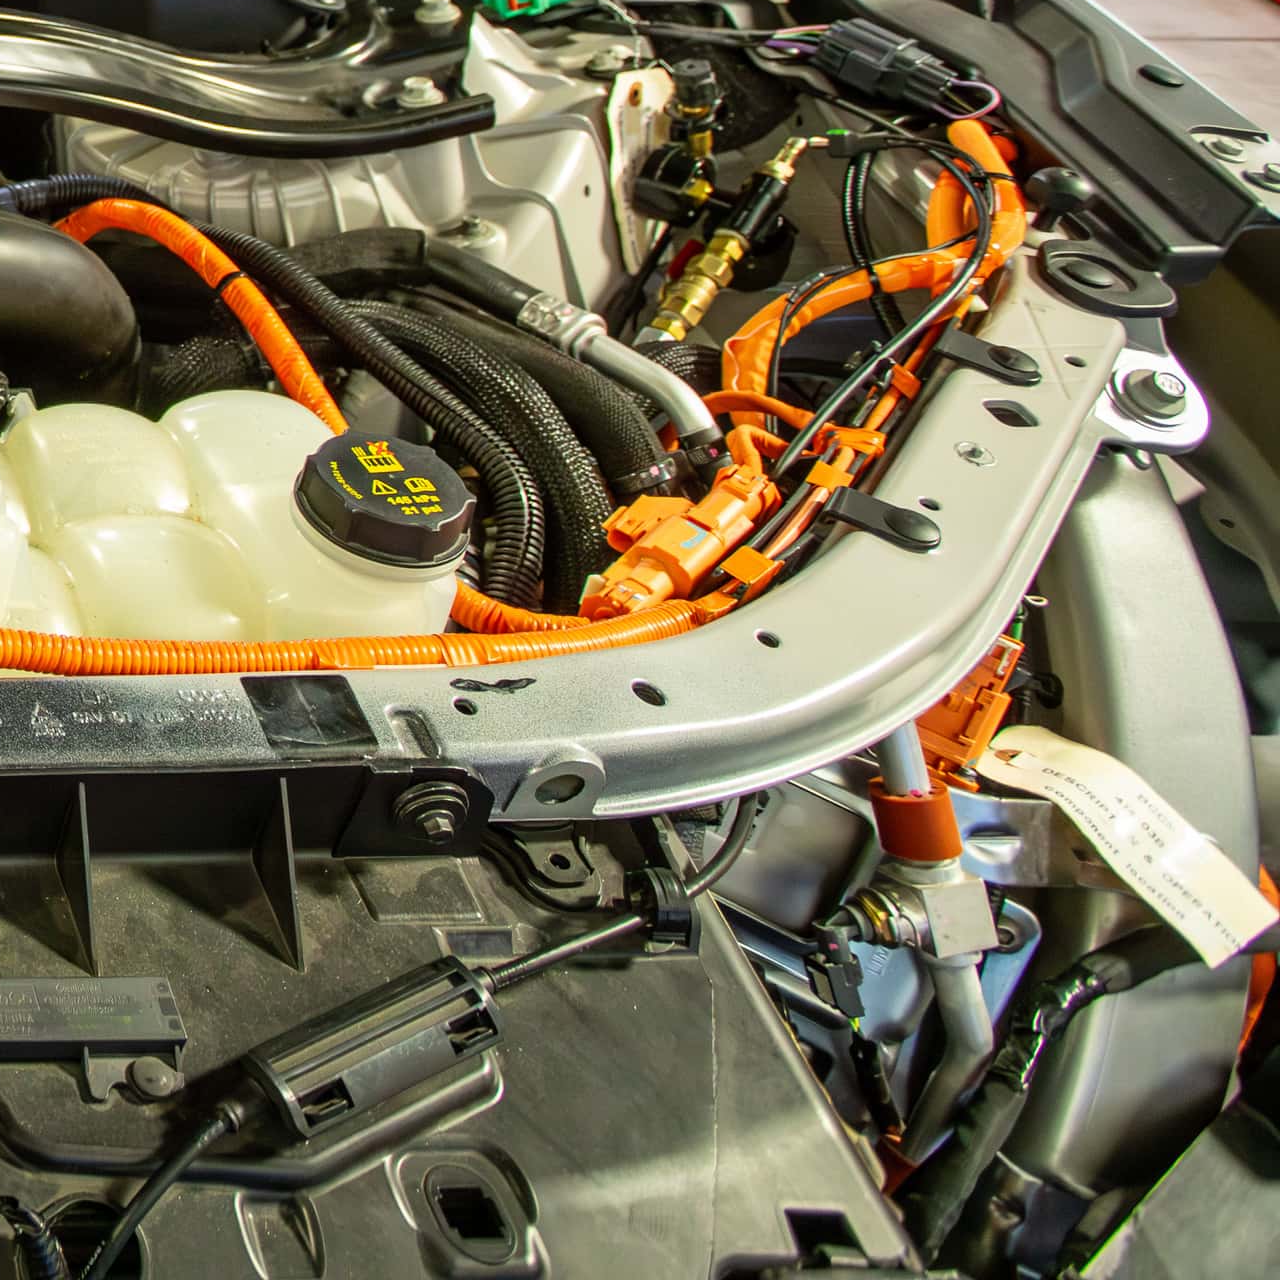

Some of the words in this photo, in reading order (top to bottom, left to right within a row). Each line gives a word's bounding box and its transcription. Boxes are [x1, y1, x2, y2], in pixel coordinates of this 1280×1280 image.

[401, 506, 420, 516] 21
[421, 504, 443, 516] psi
[412, 494, 440, 504] kPa
[1041, 766, 1139, 846] DESCRIPTN
[1043, 784, 1120, 856] component
[1125, 862, 1186, 921] location
